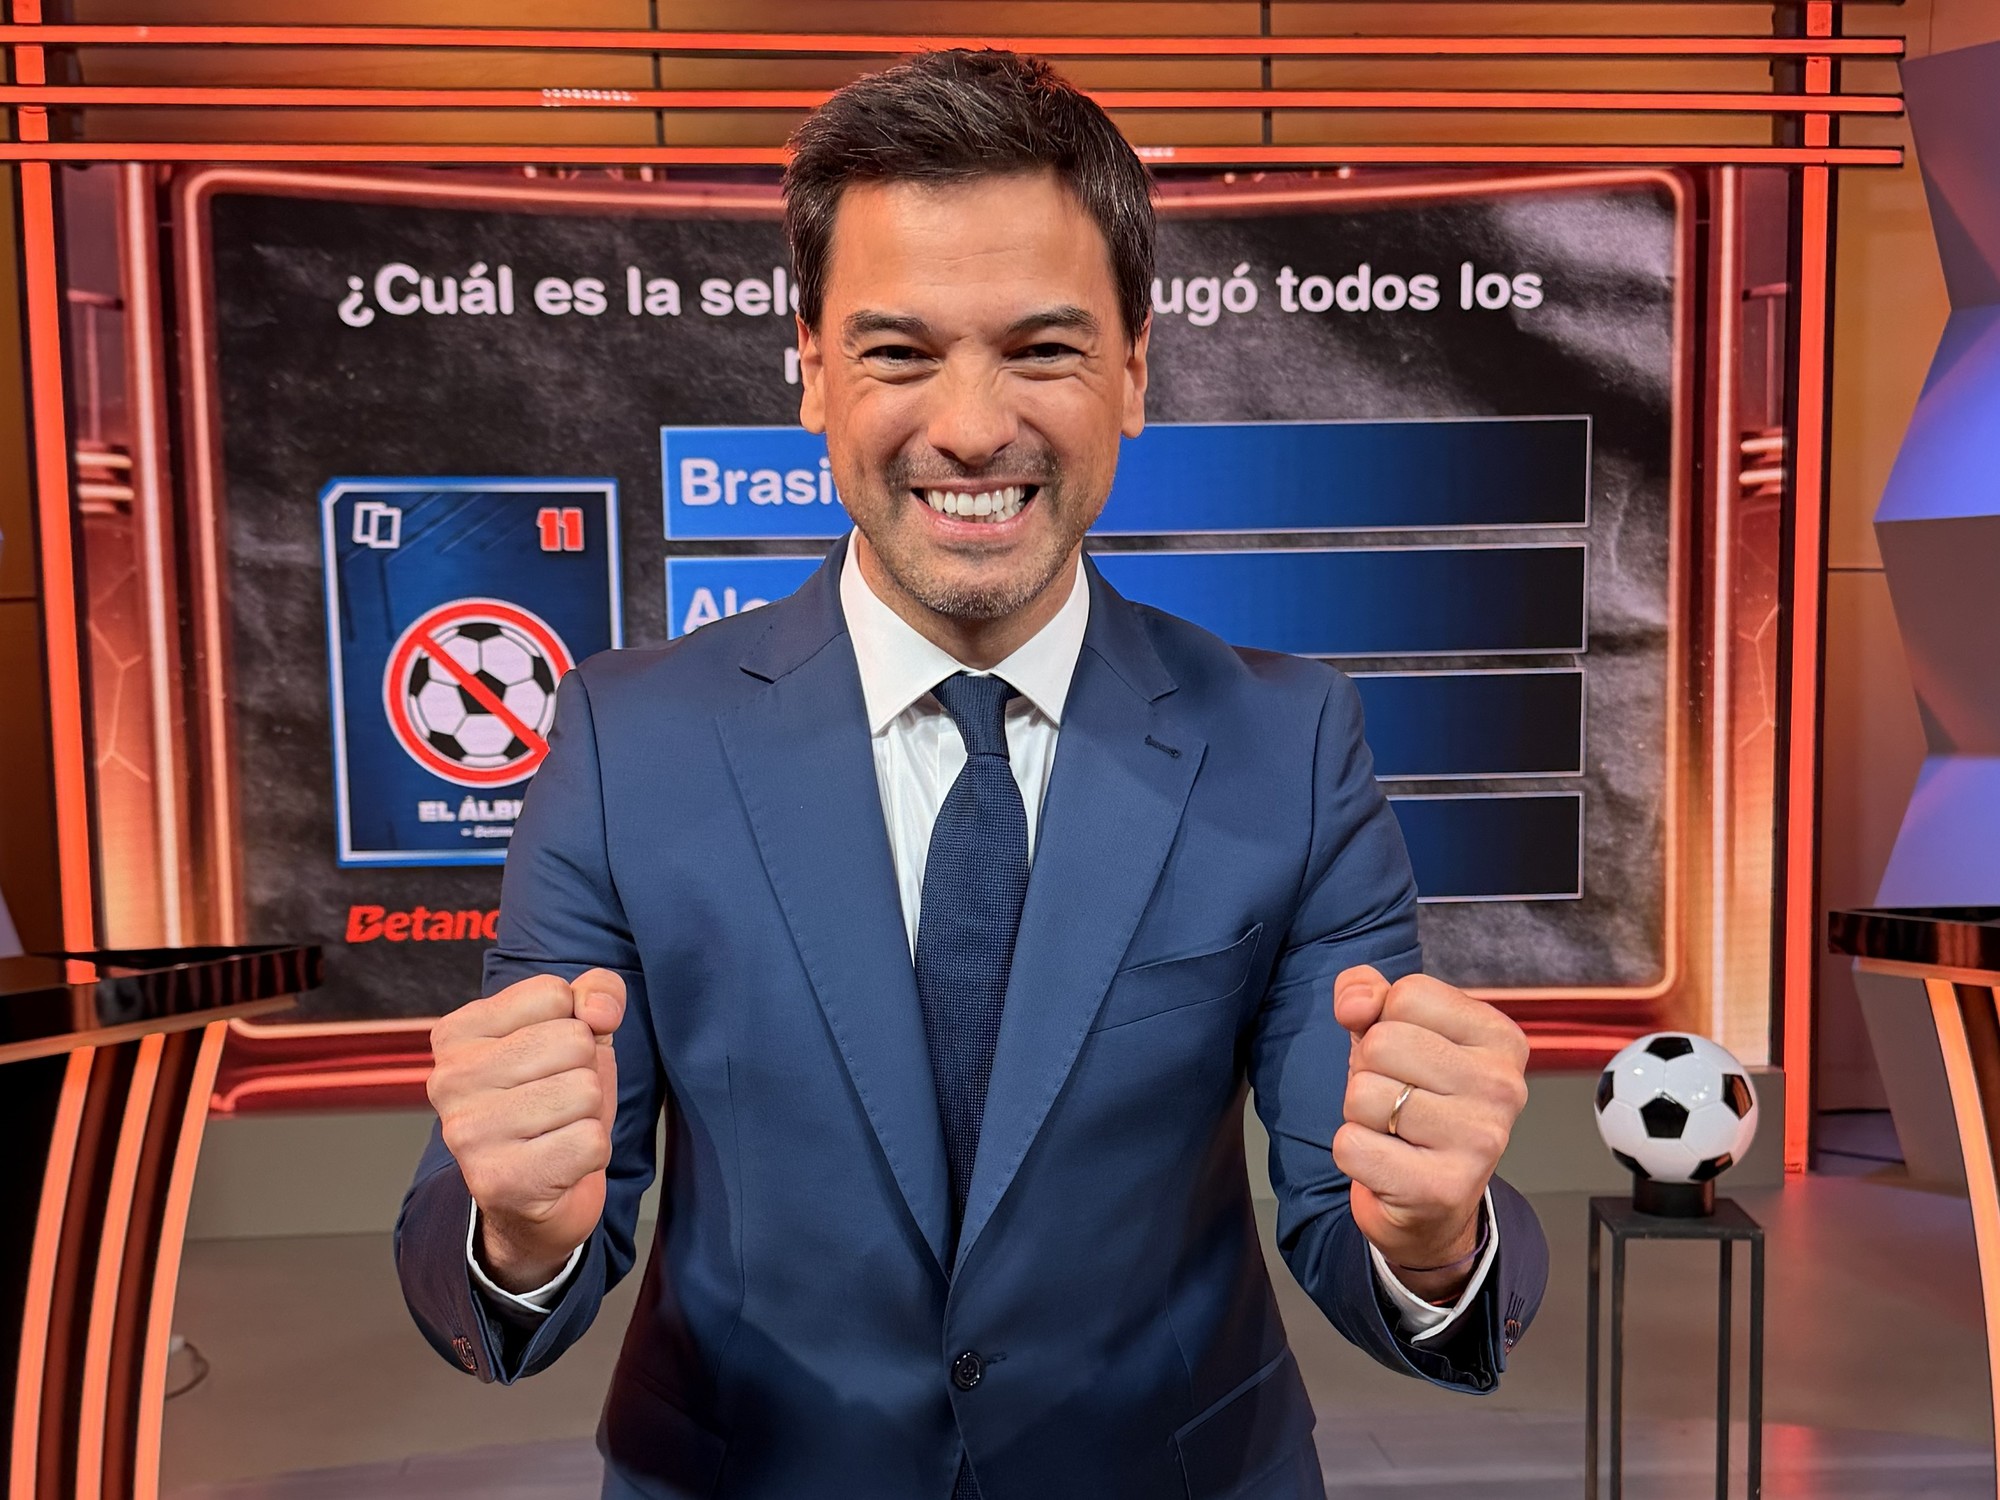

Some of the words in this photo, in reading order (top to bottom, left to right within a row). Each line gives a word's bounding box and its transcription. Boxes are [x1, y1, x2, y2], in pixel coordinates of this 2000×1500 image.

[338, 262, 514, 327] ¿Cuál
[533, 277, 608, 316] es
[627, 265, 682, 316] la
[699, 266, 799, 316] sel
[1150, 261, 1259, 327] ugó
[1276, 262, 1441, 313] todos
[1460, 261, 1544, 311] los
[680, 457, 845, 507] Brasi
[537, 507, 585, 552] 11
[418, 800, 456, 822] EL
